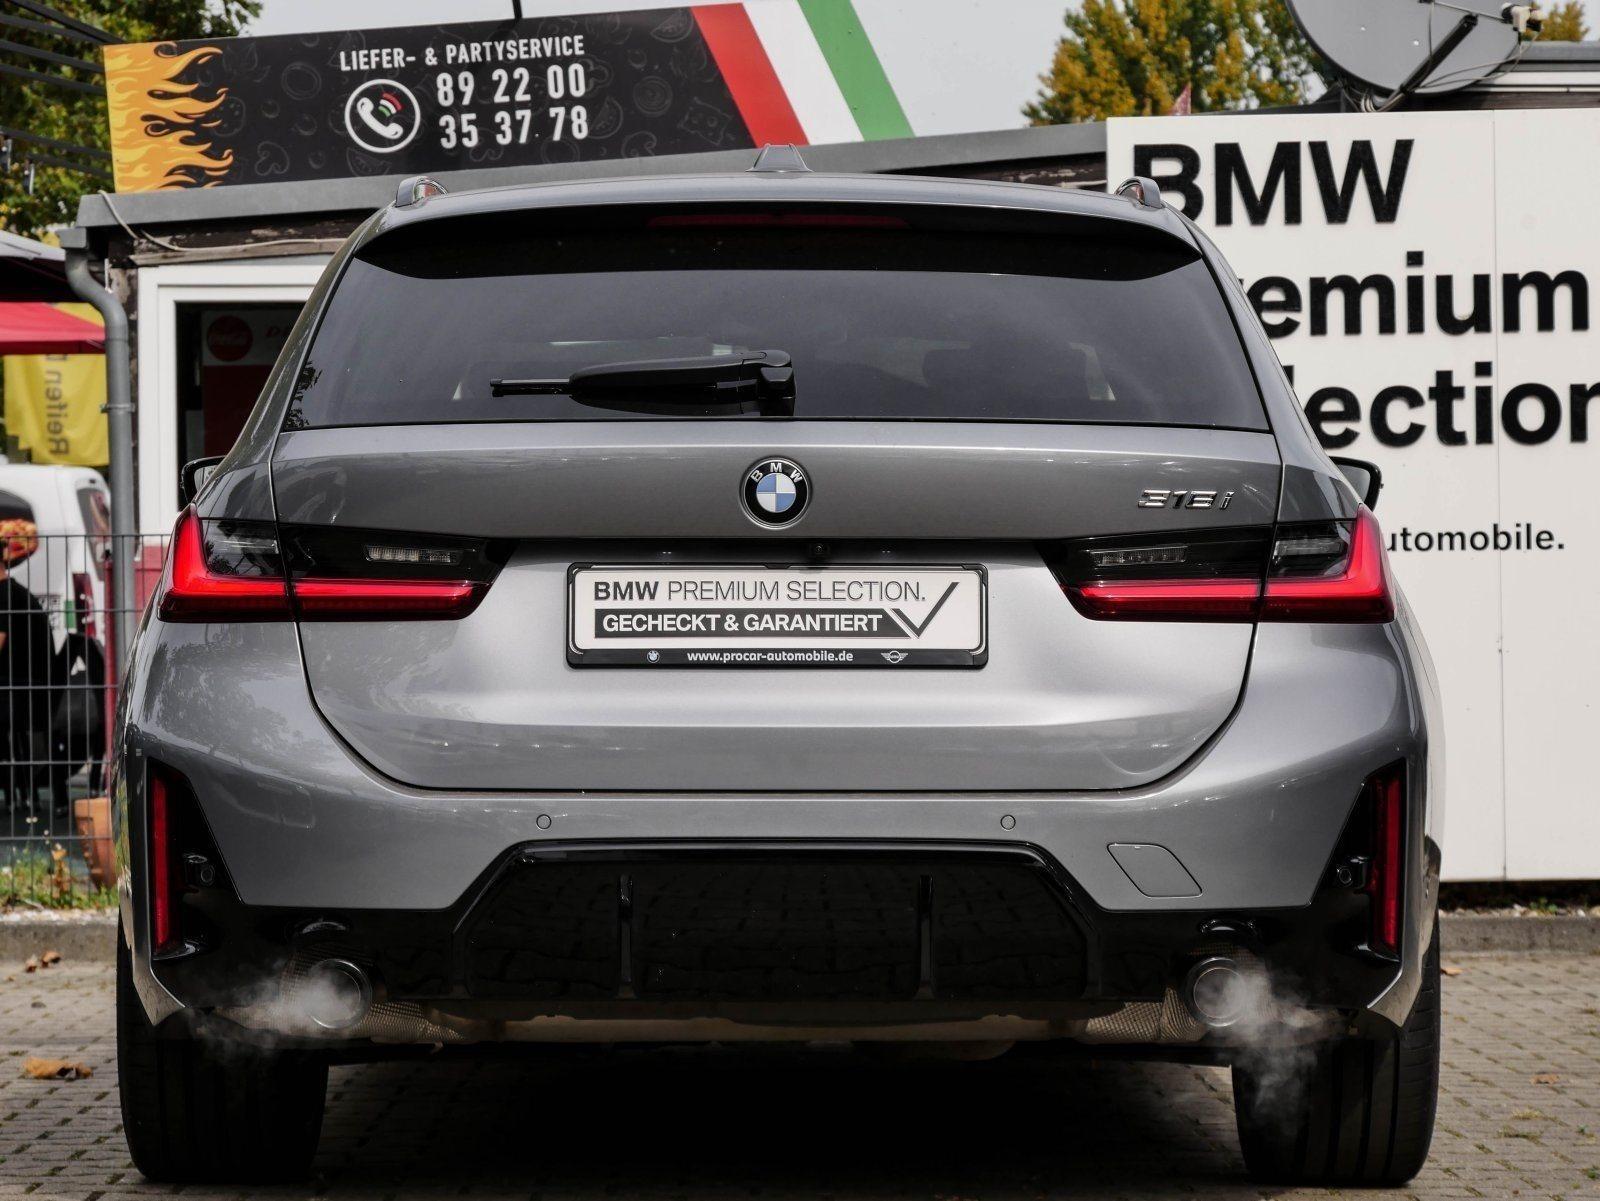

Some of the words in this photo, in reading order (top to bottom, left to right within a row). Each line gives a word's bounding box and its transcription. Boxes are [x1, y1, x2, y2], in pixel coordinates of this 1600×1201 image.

[340, 48, 416, 71] LIEFER-
[425, 47, 438, 66] &
[446, 35, 585, 65] PARTYSERVICE
[436, 71, 475, 107] 89
[491, 67, 531, 103] 22
[547, 63, 586, 99] 00
[439, 113, 479, 149] 35
[494, 109, 532, 145] 37
[549, 105, 589, 141] 78
[1134, 139, 1414, 226] BMW
[1239, 251, 1589, 340] emium
[750, 462, 803, 483] BMW
[1387, 522, 1565, 551] utomobile.
[594, 581, 659, 601] BMW
[668, 581, 779, 601] PREMIUM
[787, 581, 925, 601] SELECTION.
[603, 614, 721, 632] GECHECKT
[724, 614, 739, 631] &
[743, 614, 882, 632] GARANTIERT
[687, 651, 854, 663] www.procar-automobile.de
